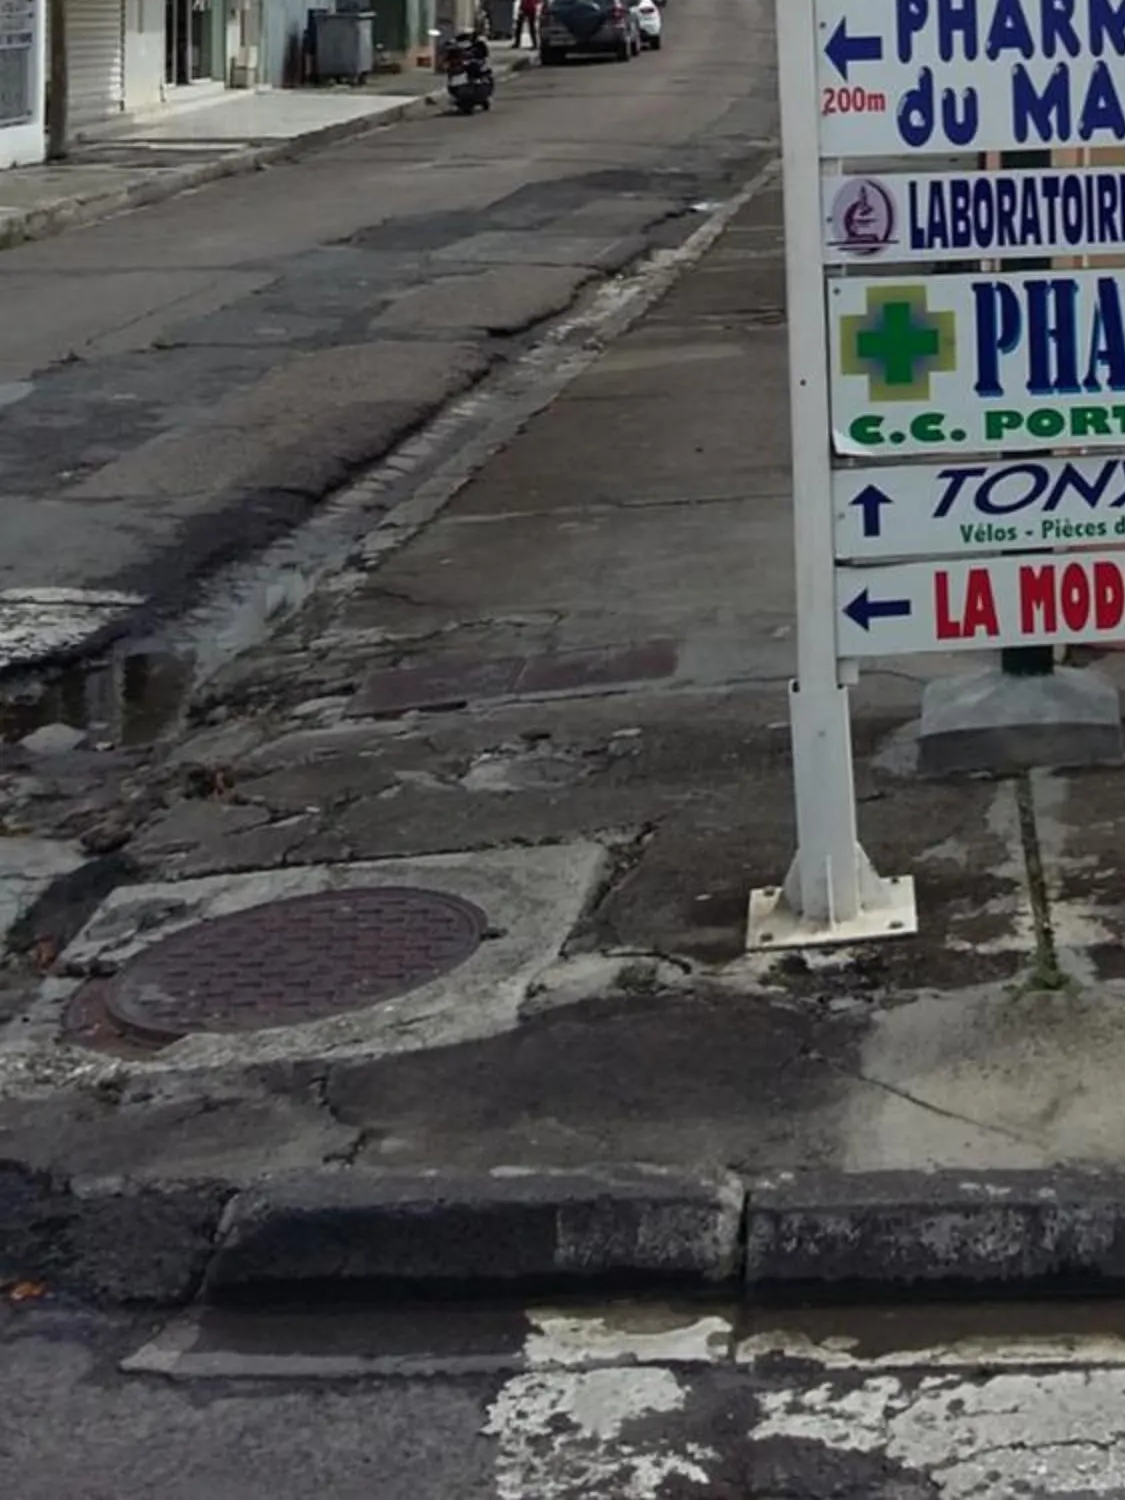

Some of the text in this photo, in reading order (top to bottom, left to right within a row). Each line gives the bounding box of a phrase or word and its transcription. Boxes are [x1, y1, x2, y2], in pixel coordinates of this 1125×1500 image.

[823, 87, 886, 116] 200m
[896, 66, 979, 148] du
[849, 411, 967, 445] C.C.
[960, 523, 1017, 545] Vélos
[1041, 518, 1107, 538] Pièces
[934, 567, 1000, 640] LA
